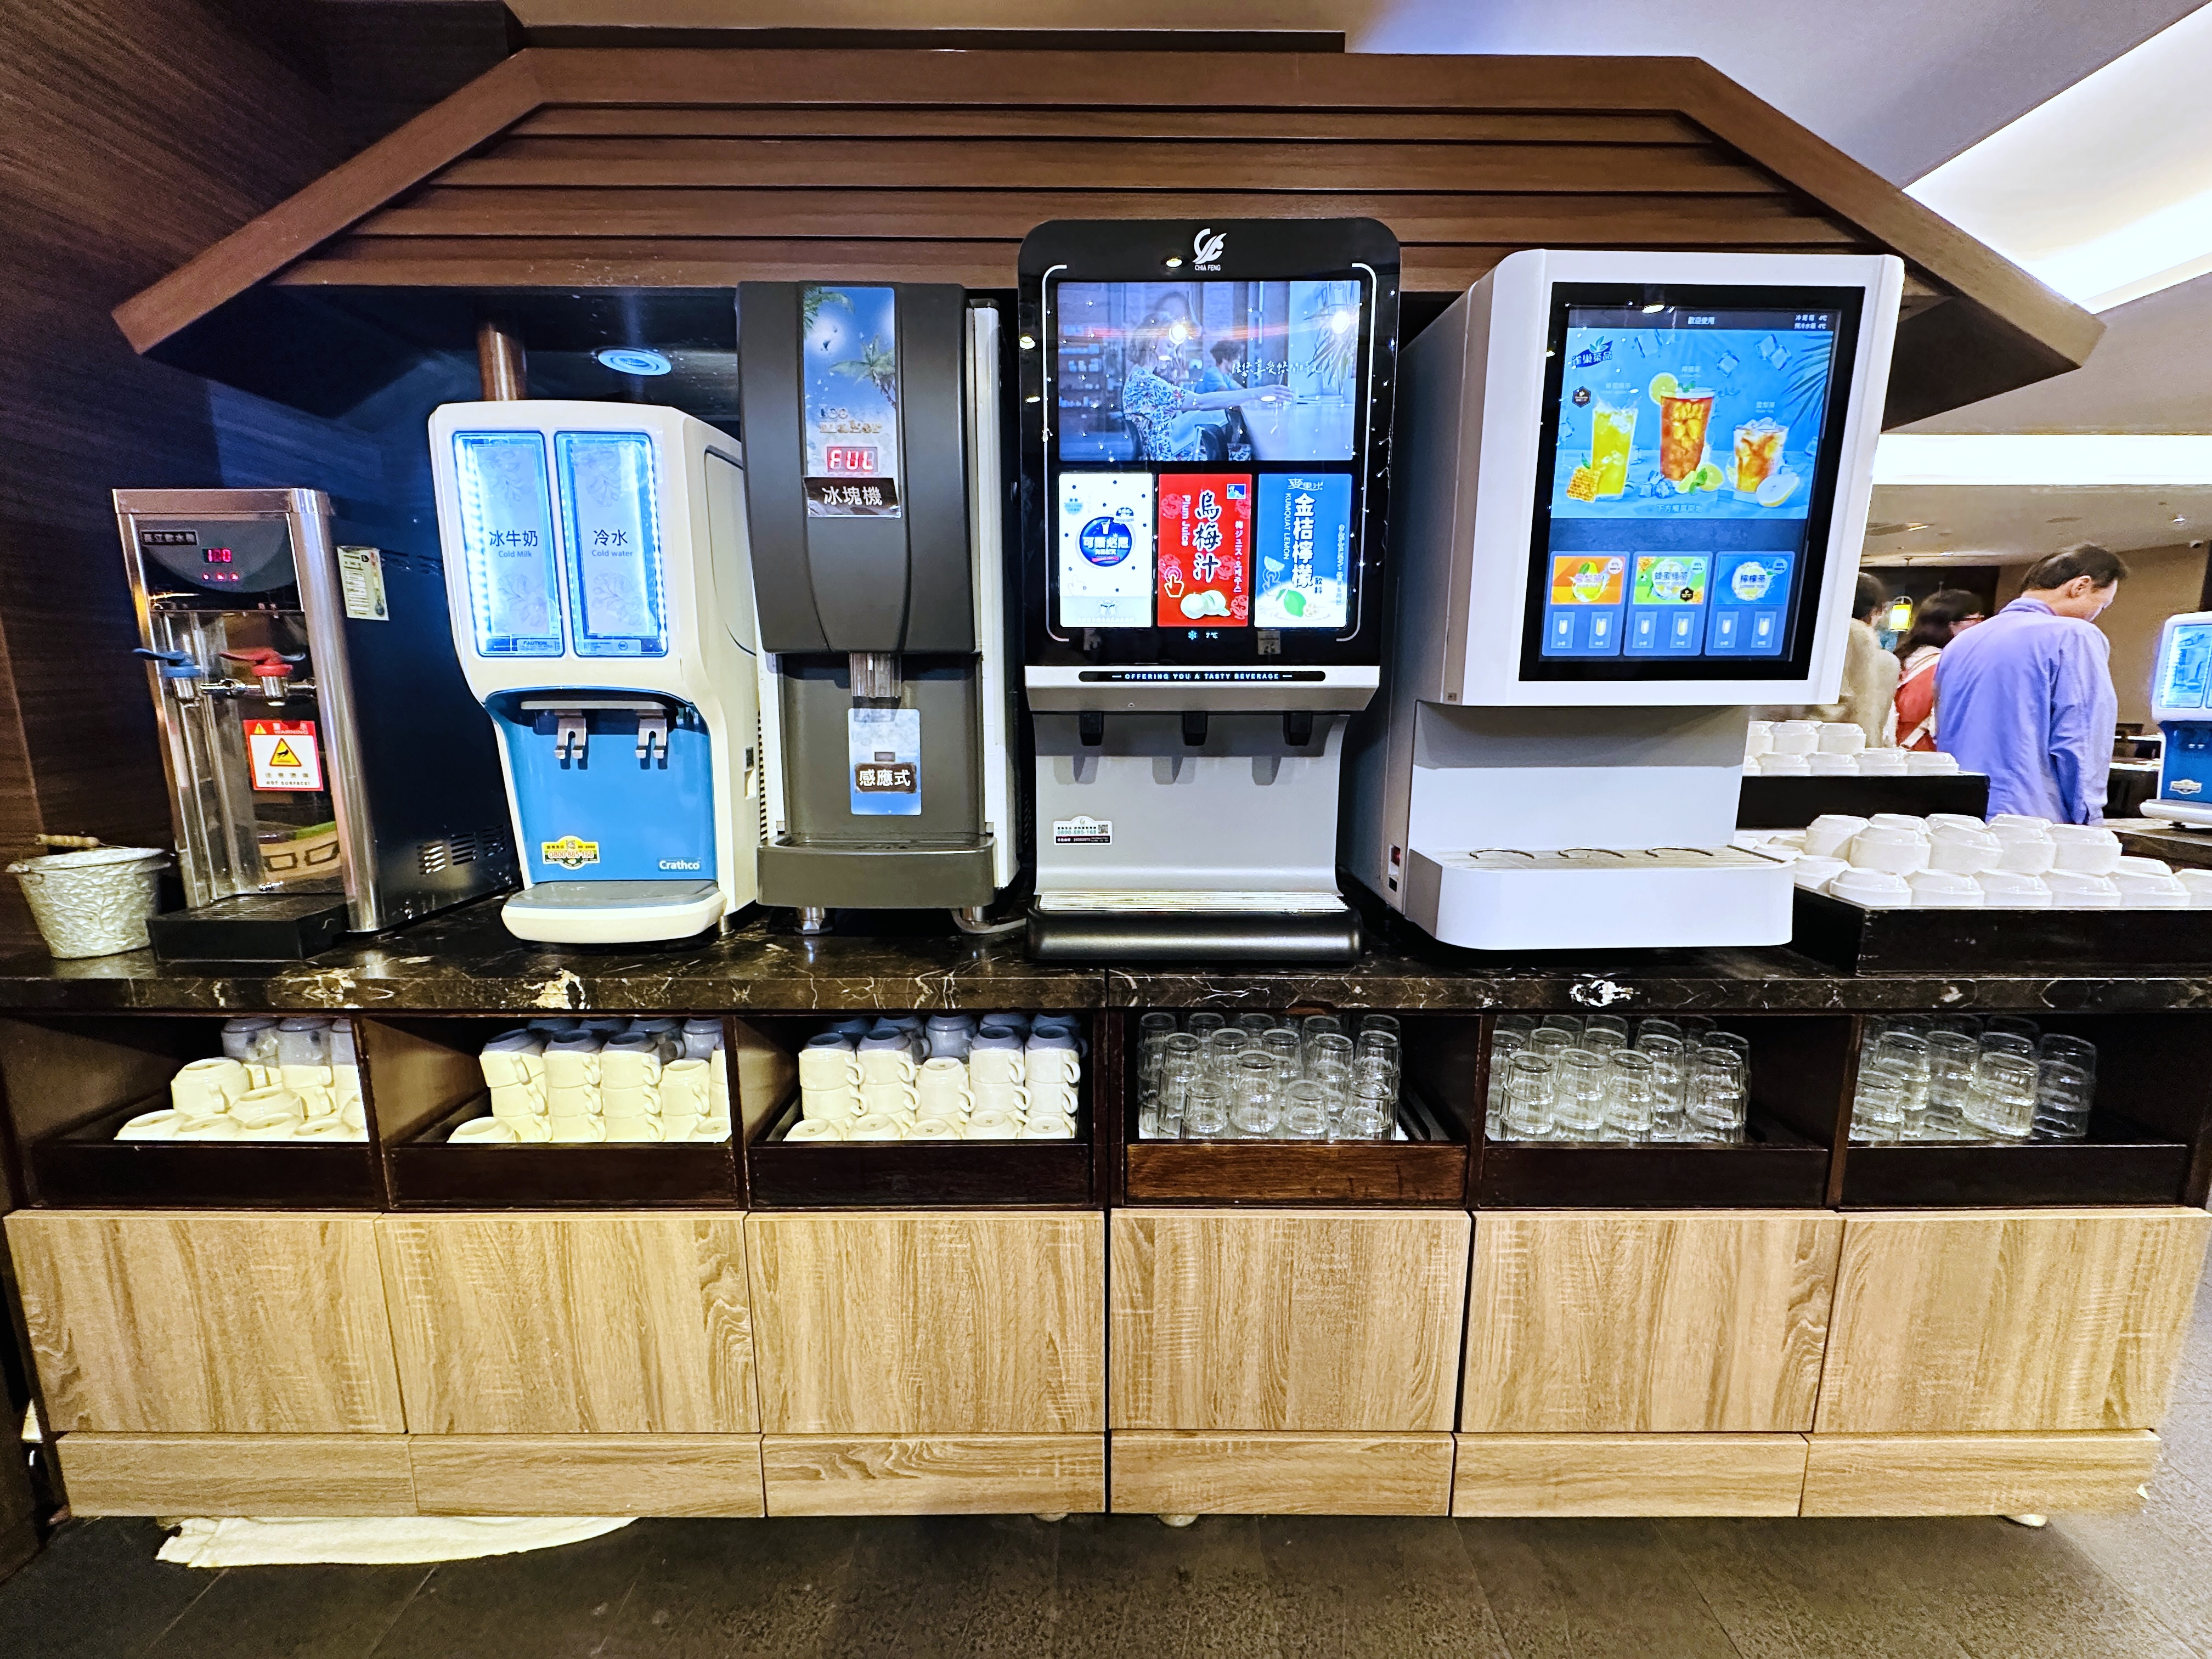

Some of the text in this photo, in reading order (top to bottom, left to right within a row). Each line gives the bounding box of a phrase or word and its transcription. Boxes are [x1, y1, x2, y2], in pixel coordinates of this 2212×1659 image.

[829, 448, 874, 470] FUL
[822, 486, 883, 506] 冰塊機
[1181, 495, 1191, 546] Plum Juice
[1283, 493, 1291, 531] KUMQUAT
[489, 530, 538, 546] 冰牛奶
[594, 529, 628, 546] 冷水
[1291, 493, 1317, 588] 金桔檸檬
[859, 769, 911, 787] 感應式
[659, 860, 701, 870] Crathco
